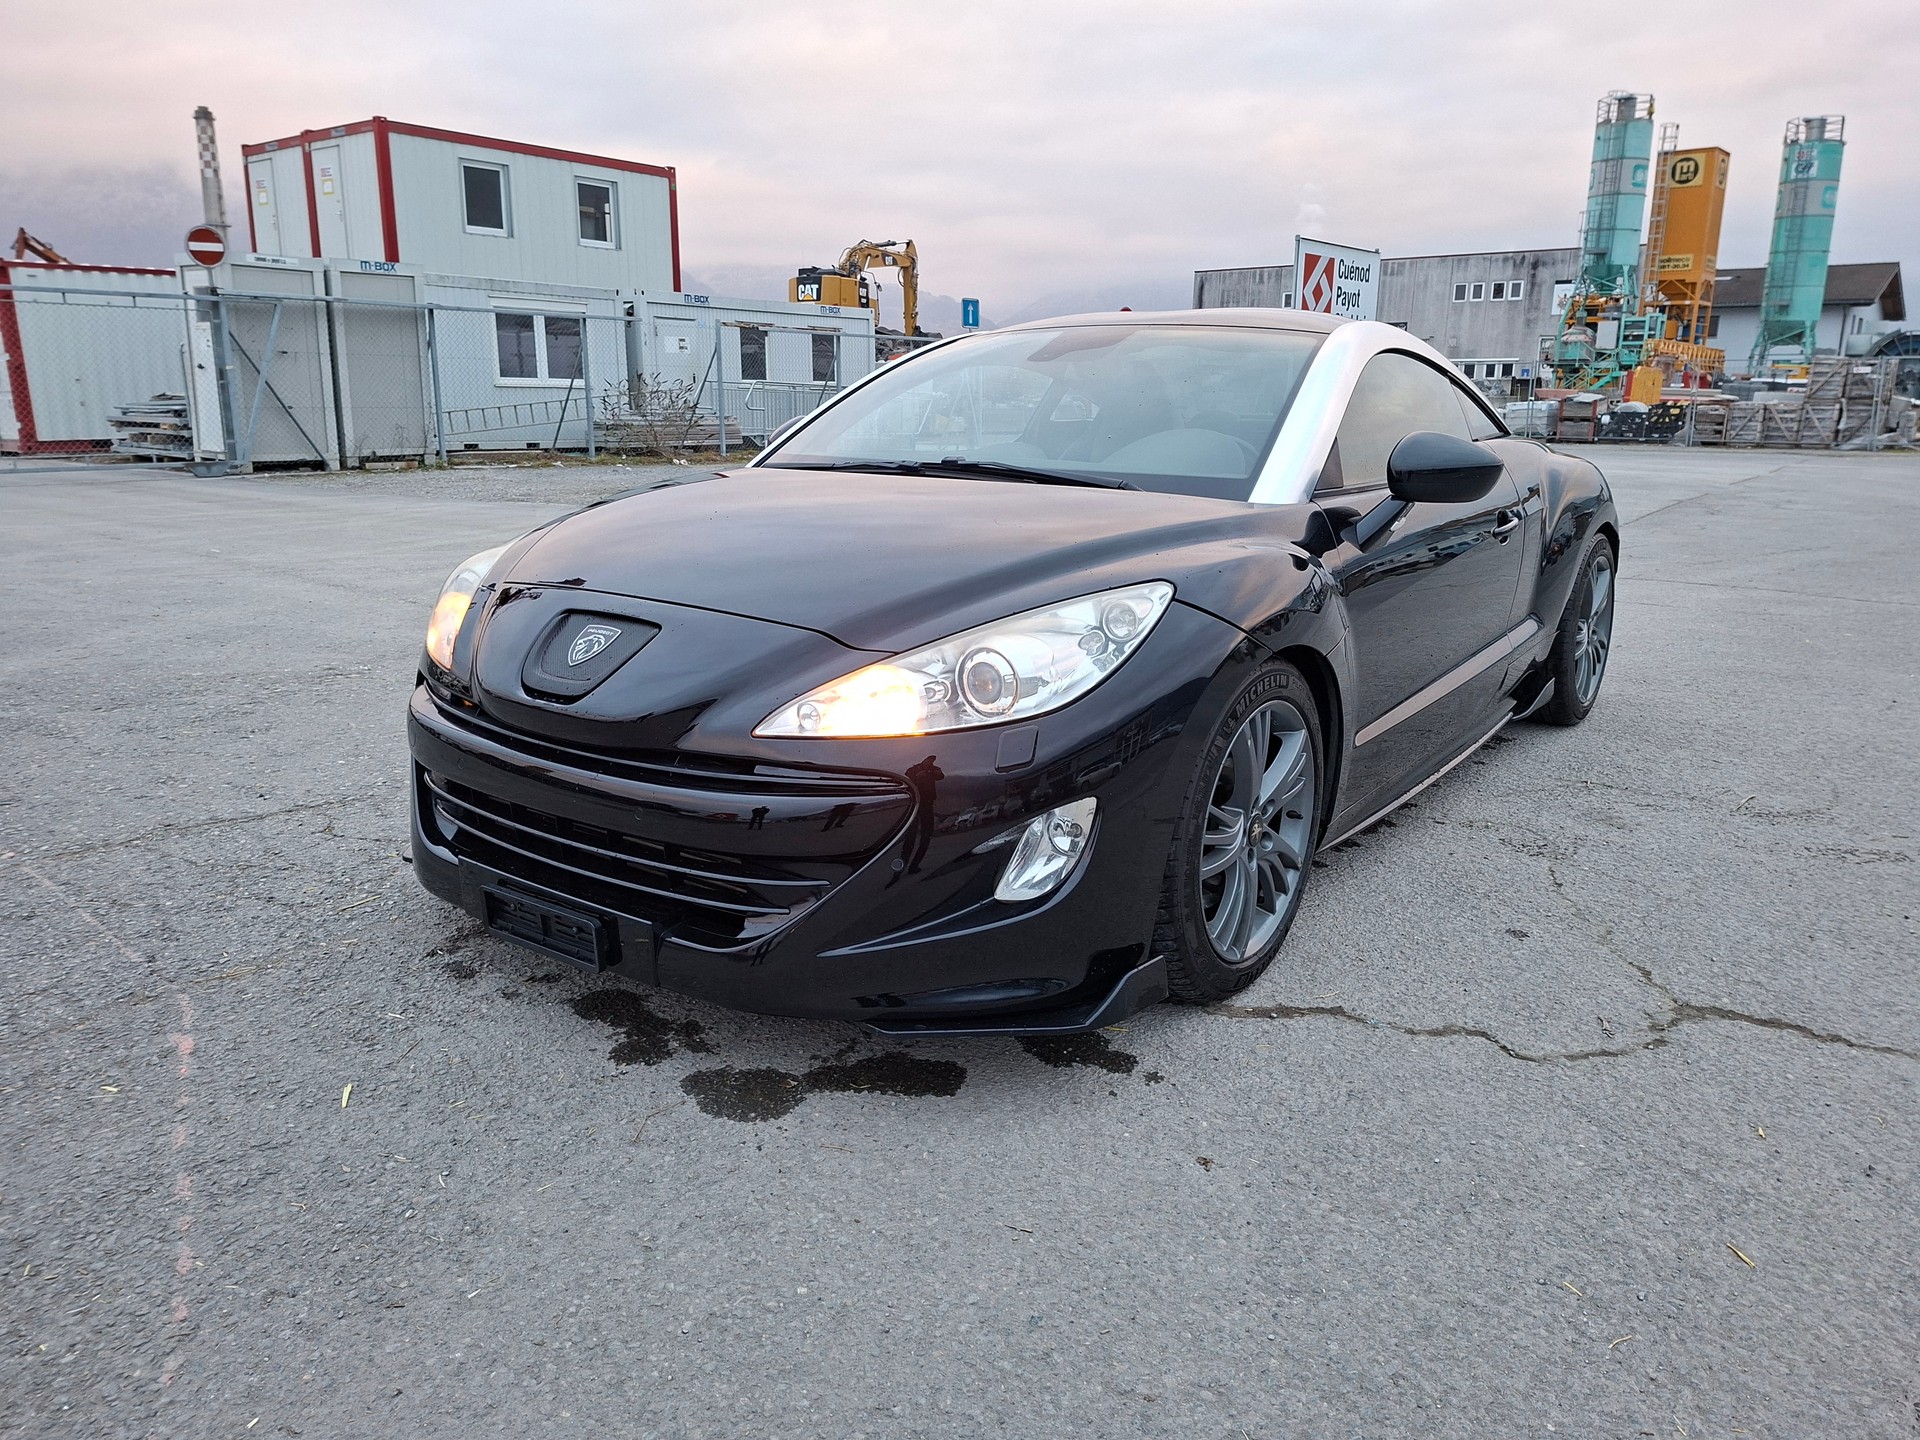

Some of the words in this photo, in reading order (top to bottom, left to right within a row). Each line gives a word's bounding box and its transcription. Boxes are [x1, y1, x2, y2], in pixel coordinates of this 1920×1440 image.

[1338, 259, 1371, 283] Cuénod
[798, 284, 819, 301] CAT
[1336, 286, 1360, 311] Payot
[588, 628, 614, 636] PEUGEOT
[1235, 674, 1288, 718] MICHELIN
